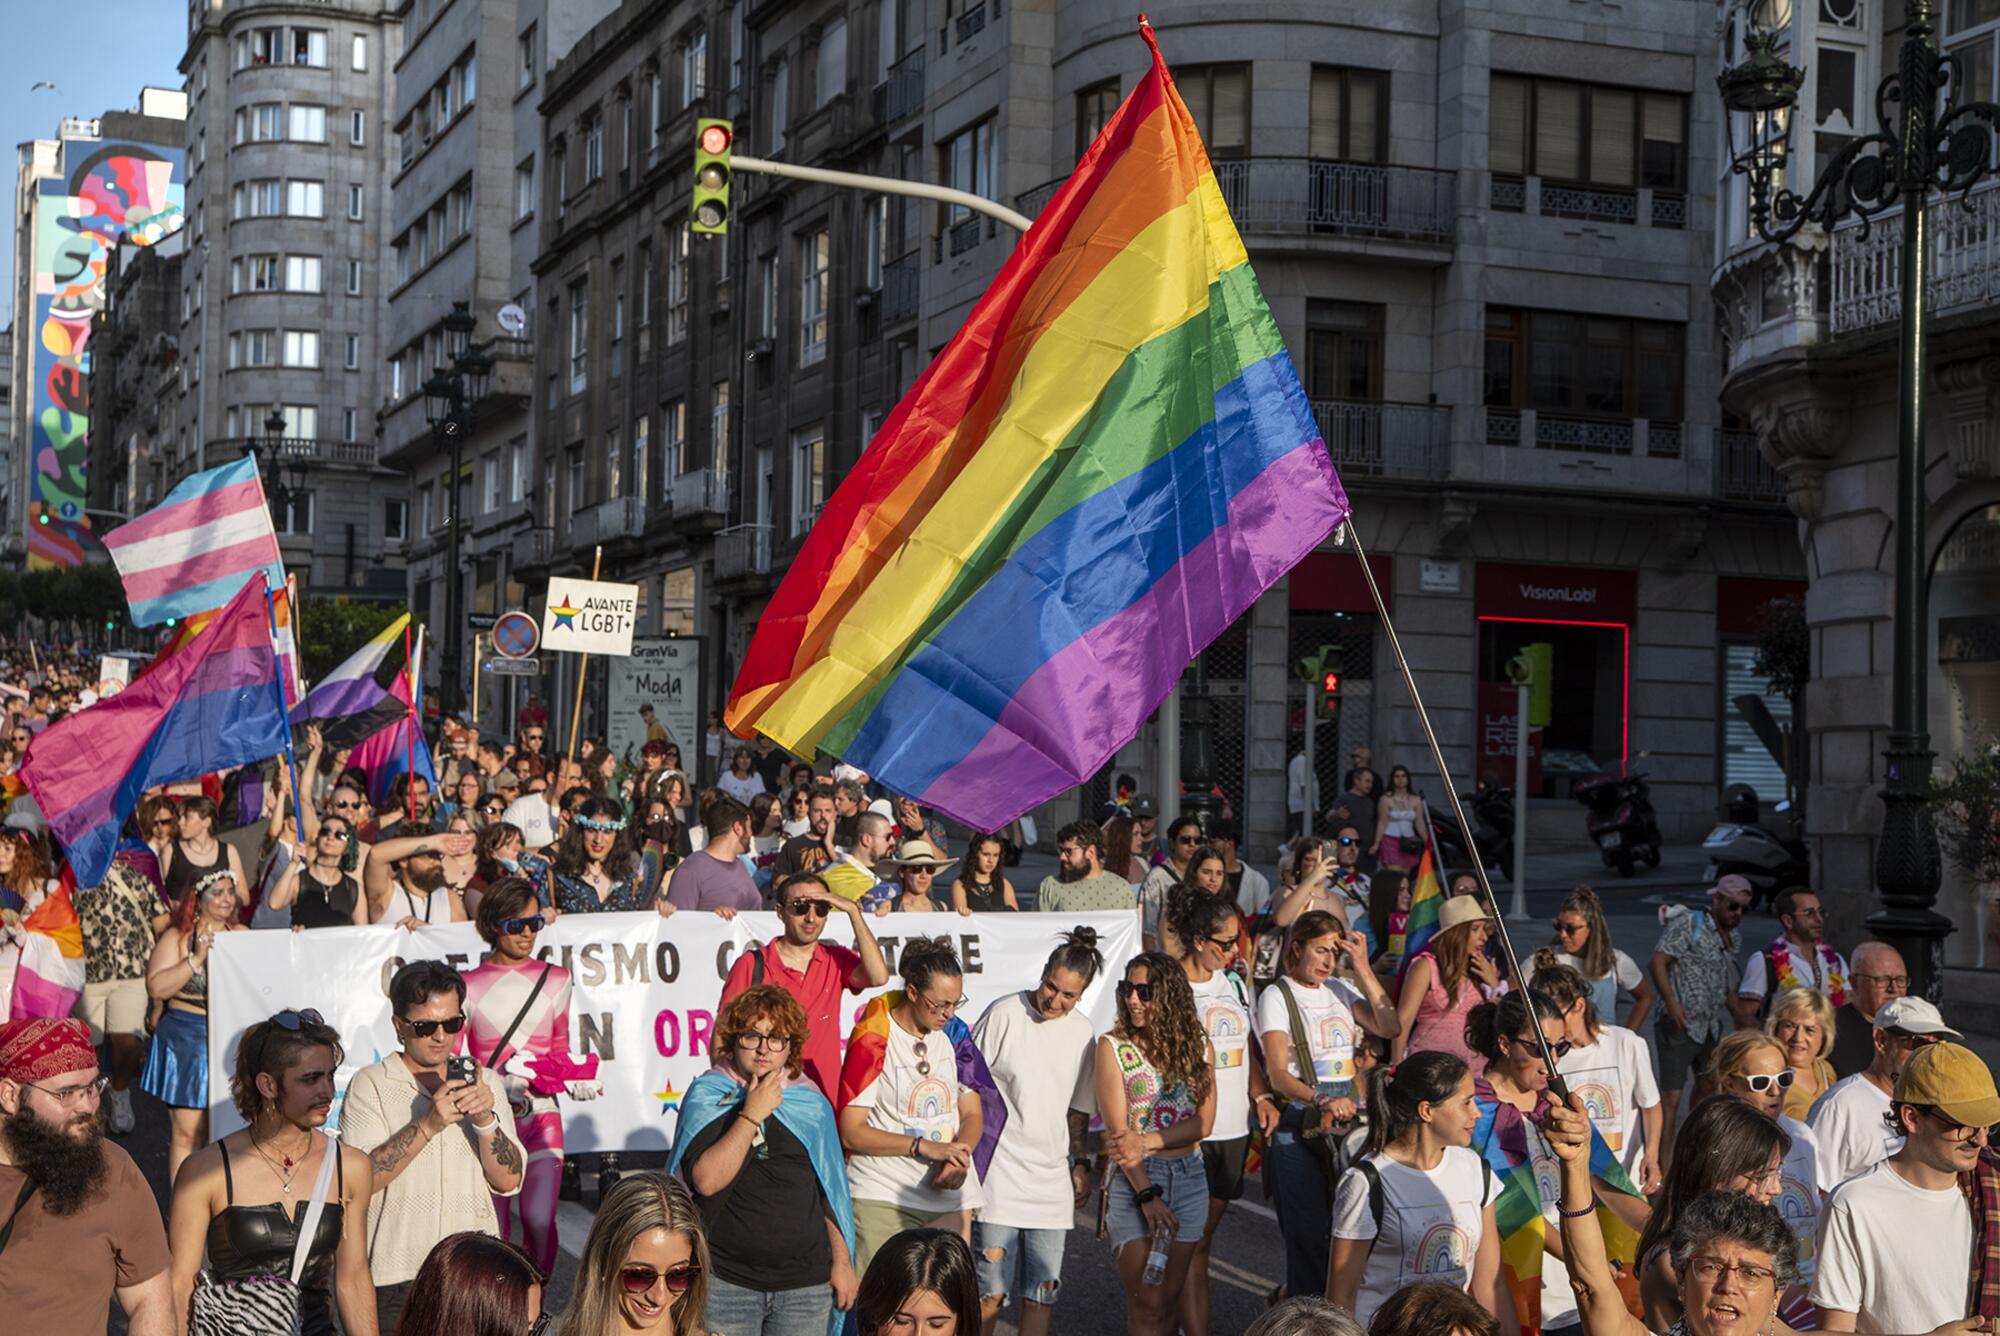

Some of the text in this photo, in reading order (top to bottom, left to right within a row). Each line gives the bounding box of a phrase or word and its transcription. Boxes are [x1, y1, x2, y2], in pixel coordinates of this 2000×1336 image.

[583, 597, 632, 613] AVANTE
[580, 613, 631, 633] LGBT+
[636, 672, 682, 699] Moda
